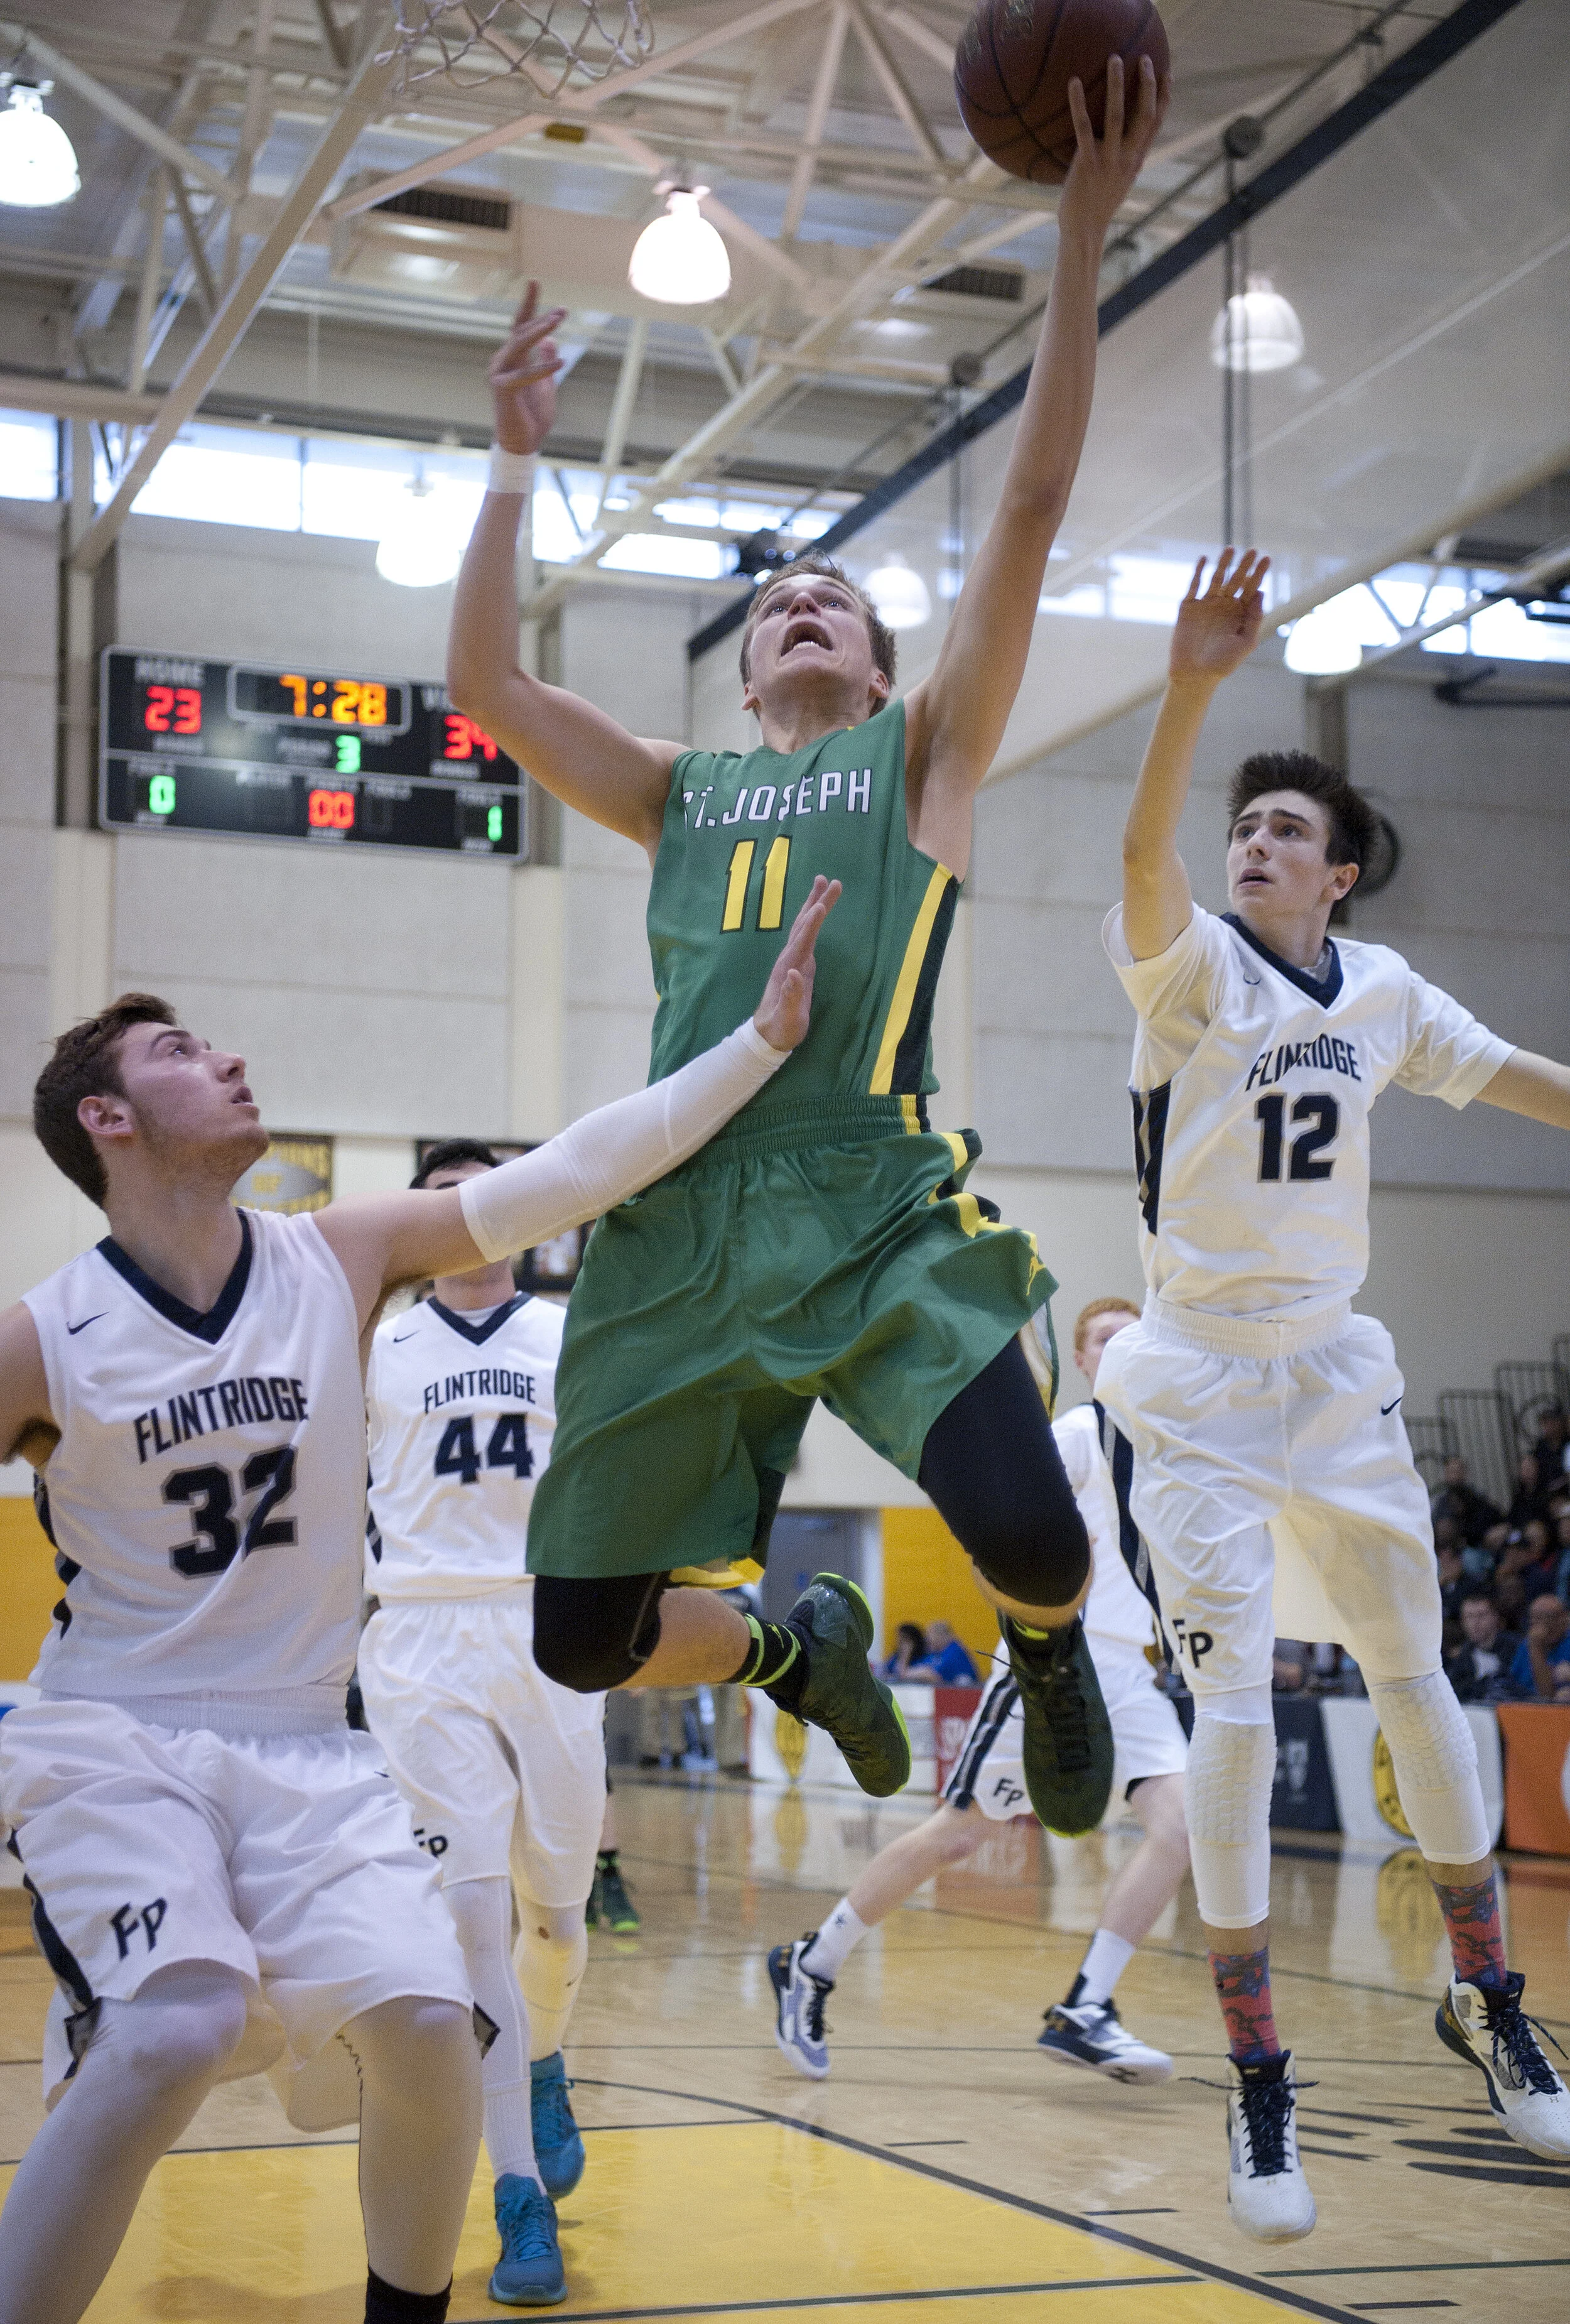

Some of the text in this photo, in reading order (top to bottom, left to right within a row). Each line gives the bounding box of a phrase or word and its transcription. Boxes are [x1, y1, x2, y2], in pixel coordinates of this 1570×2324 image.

[144, 685, 202, 735] 23
[280, 674, 387, 727] 7:28
[335, 735, 362, 774] 3
[149, 775, 176, 815] 0
[308, 789, 355, 830] 00
[487, 805, 502, 842] 1
[720, 835, 792, 933] 11
[1254, 1092, 1340, 1183] 12
[425, 1369, 536, 1414] FLINTRIDGE
[133, 1377, 309, 1465] FLINTRIDGE
[434, 1412, 535, 1485] 44
[160, 1443, 299, 1580] 32
[993, 1778, 1024, 1806] FP
[109, 1897, 168, 1960] FP
